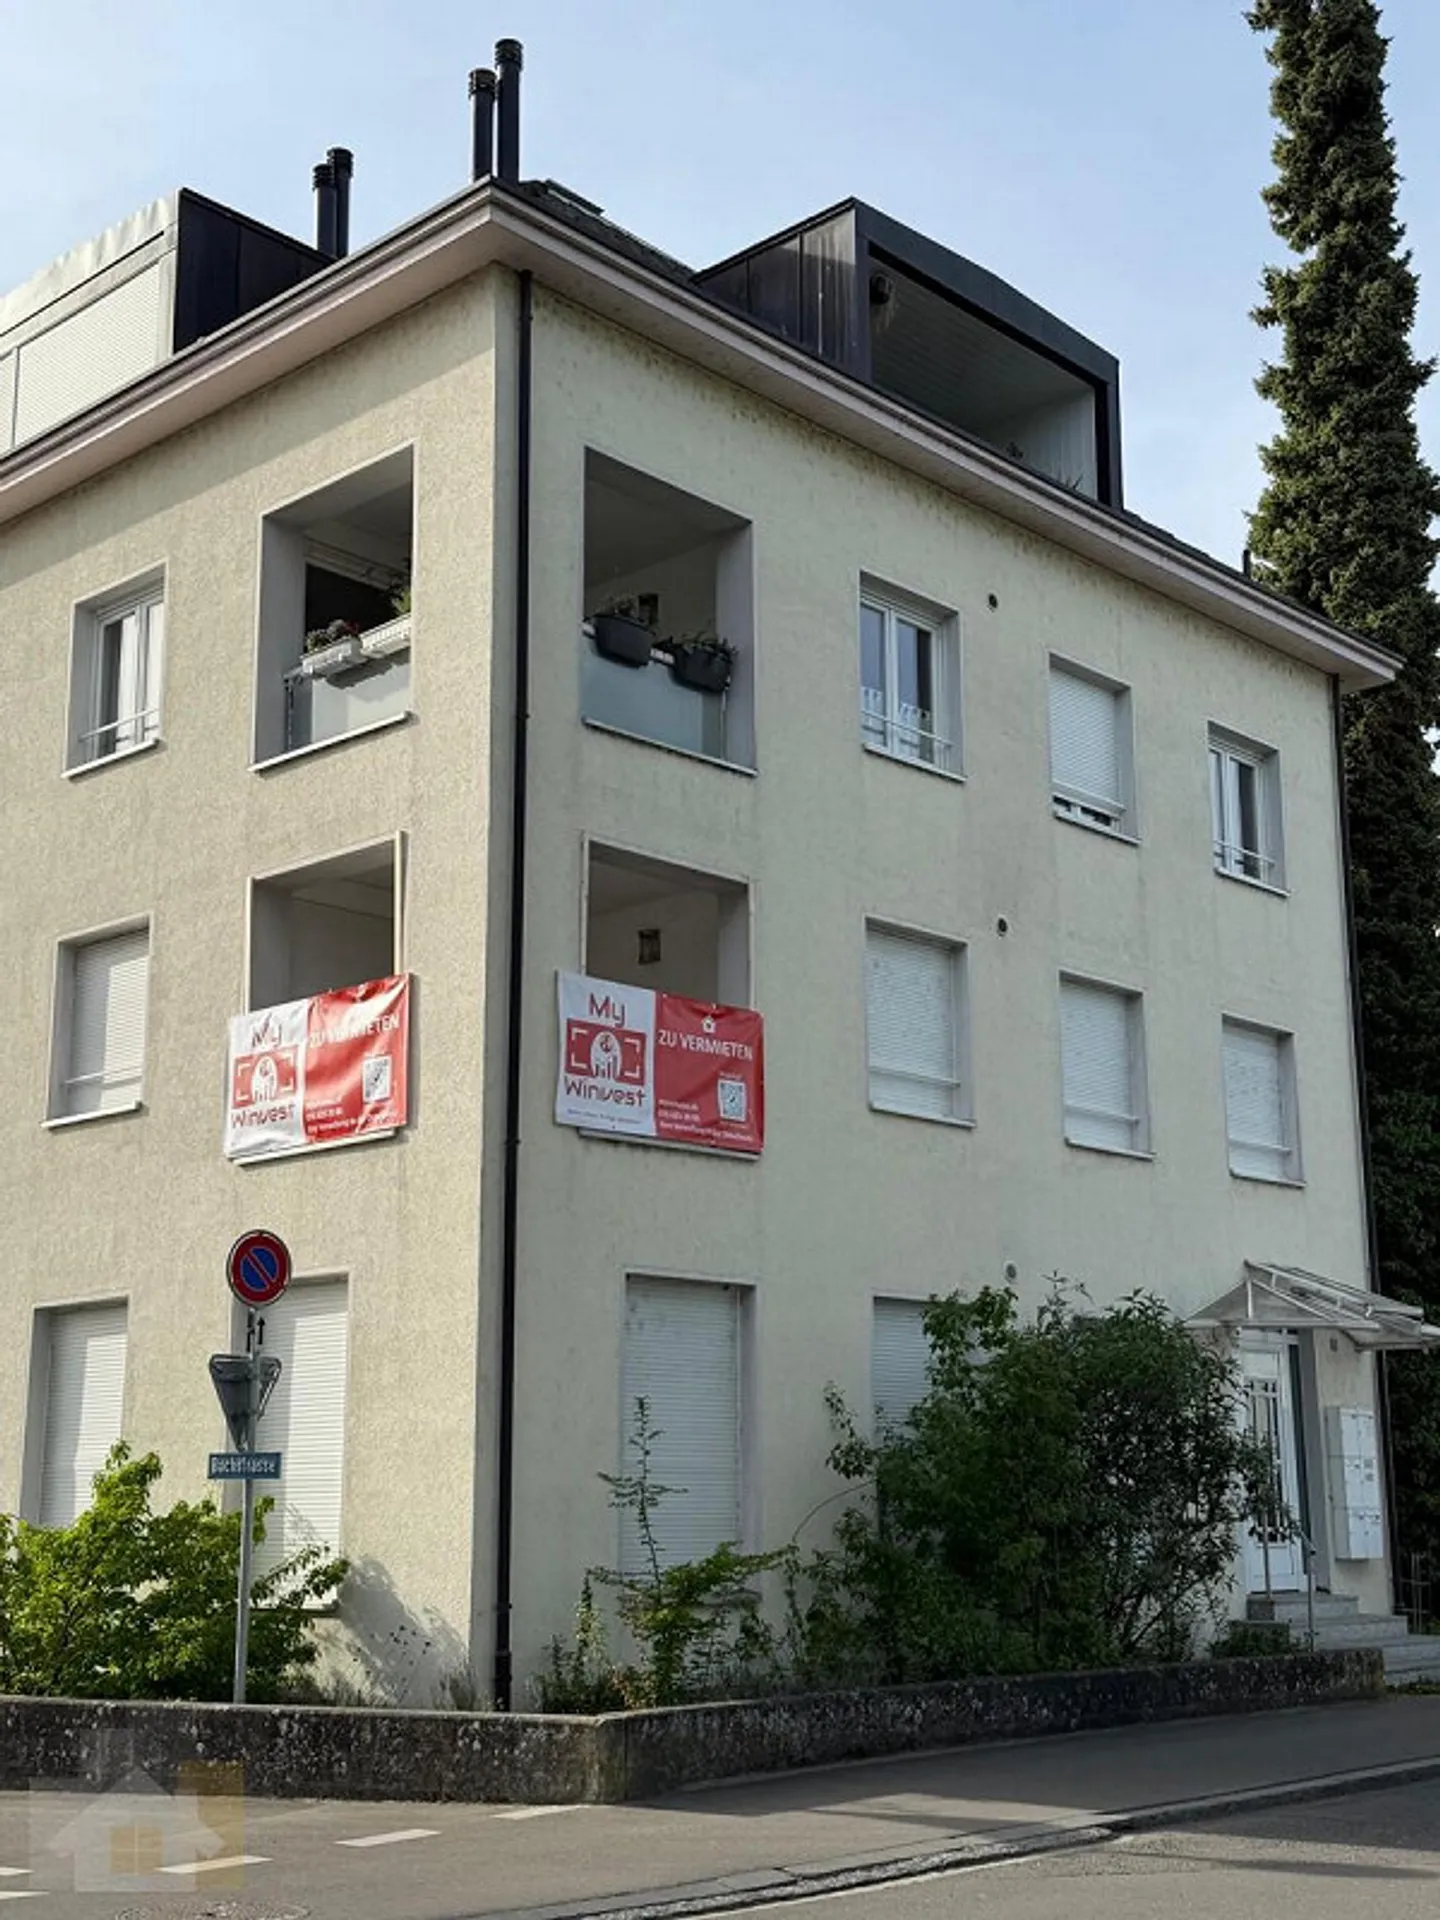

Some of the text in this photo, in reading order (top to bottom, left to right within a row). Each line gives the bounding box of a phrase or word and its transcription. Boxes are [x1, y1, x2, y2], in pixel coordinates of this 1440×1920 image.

[589, 992, 626, 1028] My
[252, 1012, 283, 1047] My
[658, 1029, 754, 1061] ZU VERMIETEN
[564, 1075, 646, 1106] Winvest
[231, 1103, 295, 1129] Winvest
